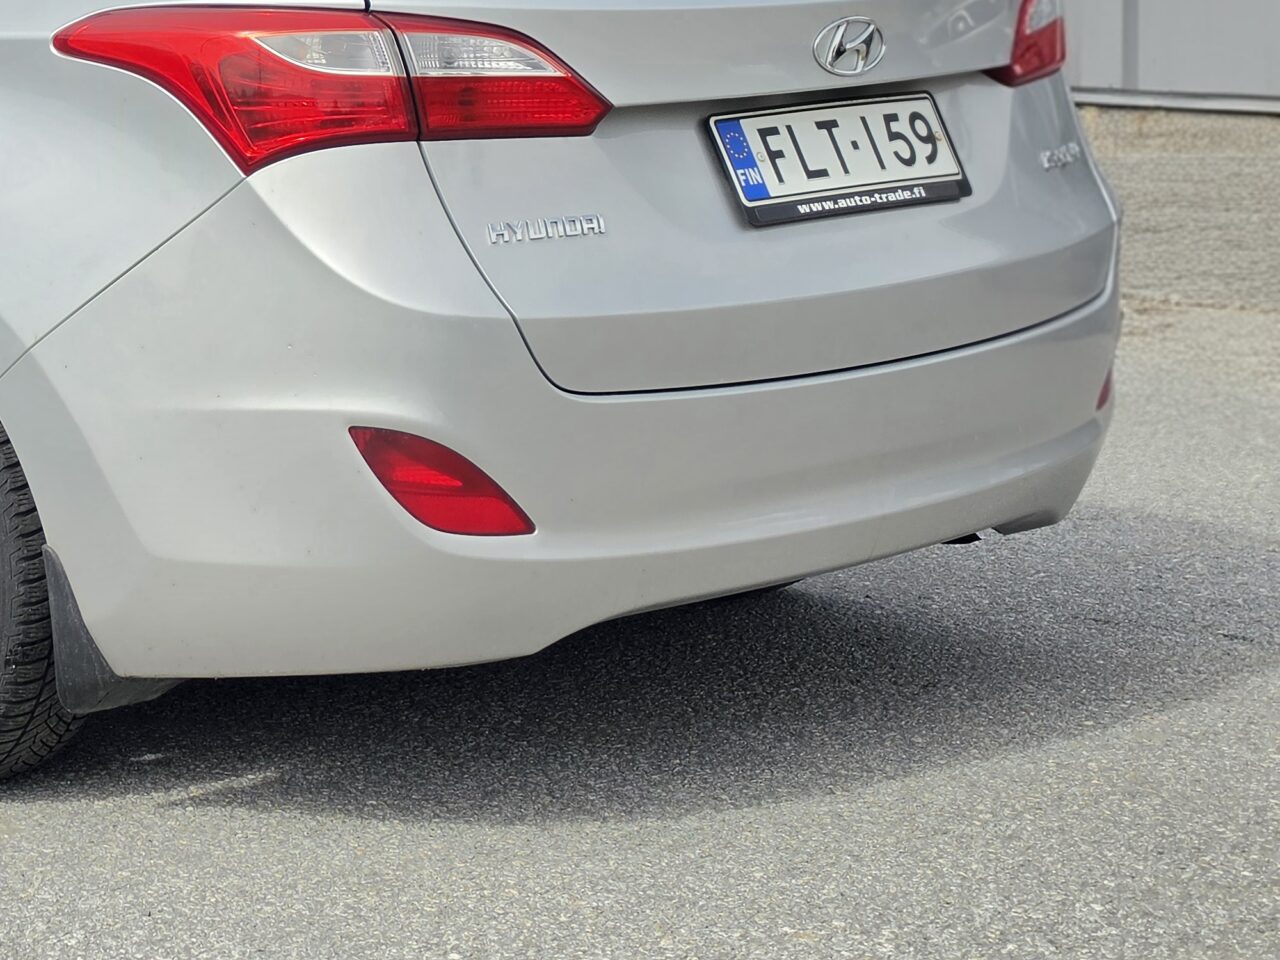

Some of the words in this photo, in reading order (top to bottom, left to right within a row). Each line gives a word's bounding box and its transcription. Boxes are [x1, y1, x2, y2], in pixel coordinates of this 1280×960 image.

[736, 166, 764, 187] FIN
[796, 185, 927, 215] www.auto-trade.fi
[487, 214, 606, 244] HYUNDAI
